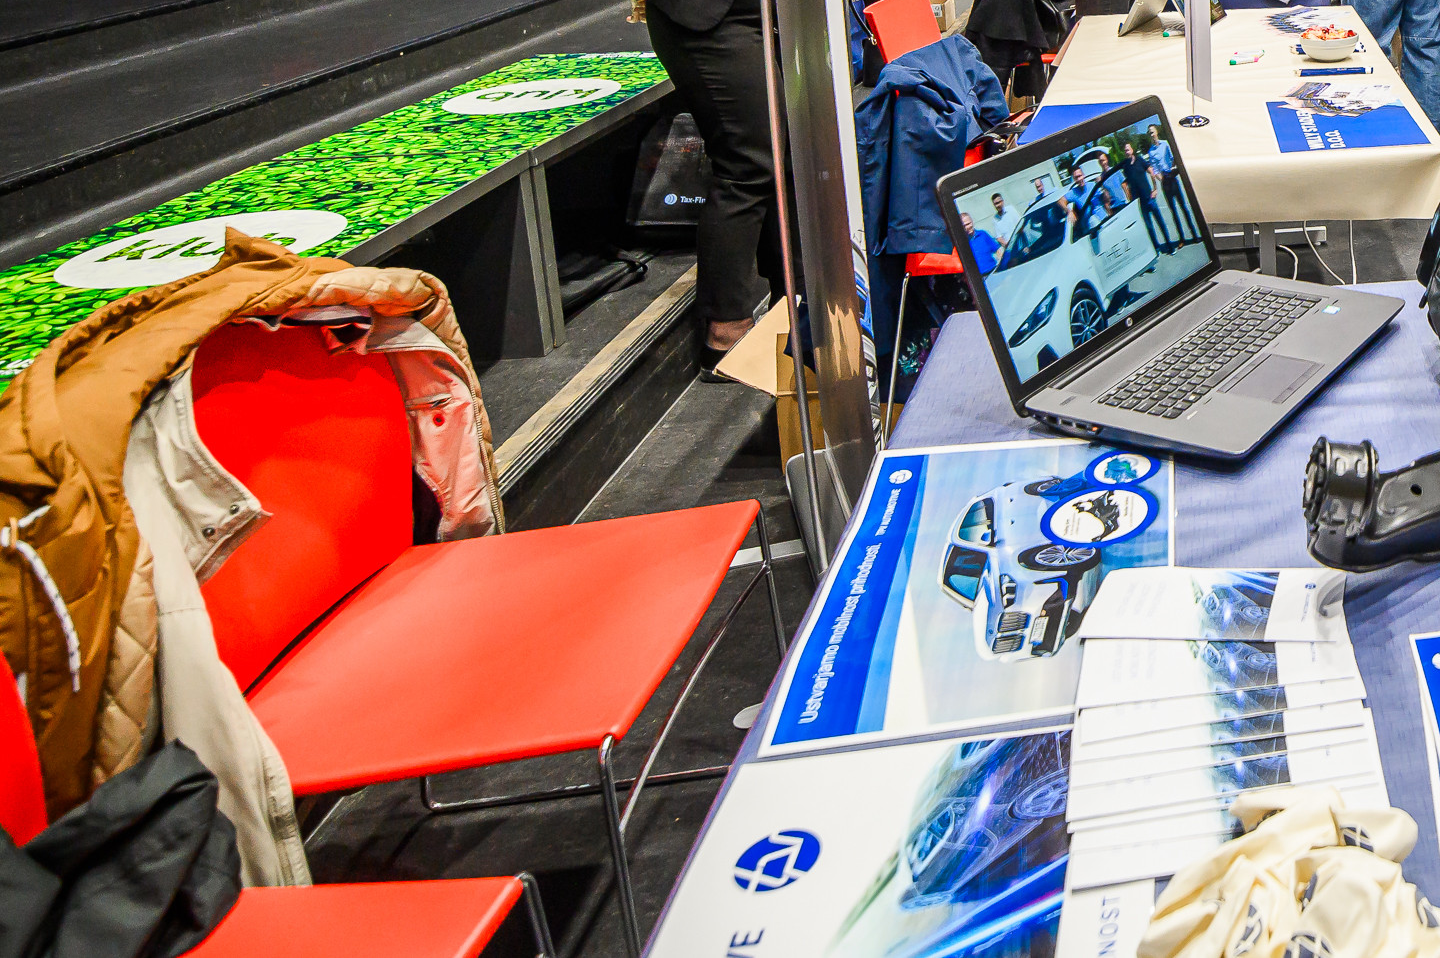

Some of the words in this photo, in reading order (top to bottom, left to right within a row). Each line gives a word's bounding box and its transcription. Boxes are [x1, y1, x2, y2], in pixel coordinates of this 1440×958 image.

[476, 87, 601, 102] klub
[1304, 132, 1326, 150] WILLY
[797, 643, 840, 725] Ustvarjamo
[828, 593, 862, 645] mobilnost
[849, 541, 883, 595] prihodnosti.
